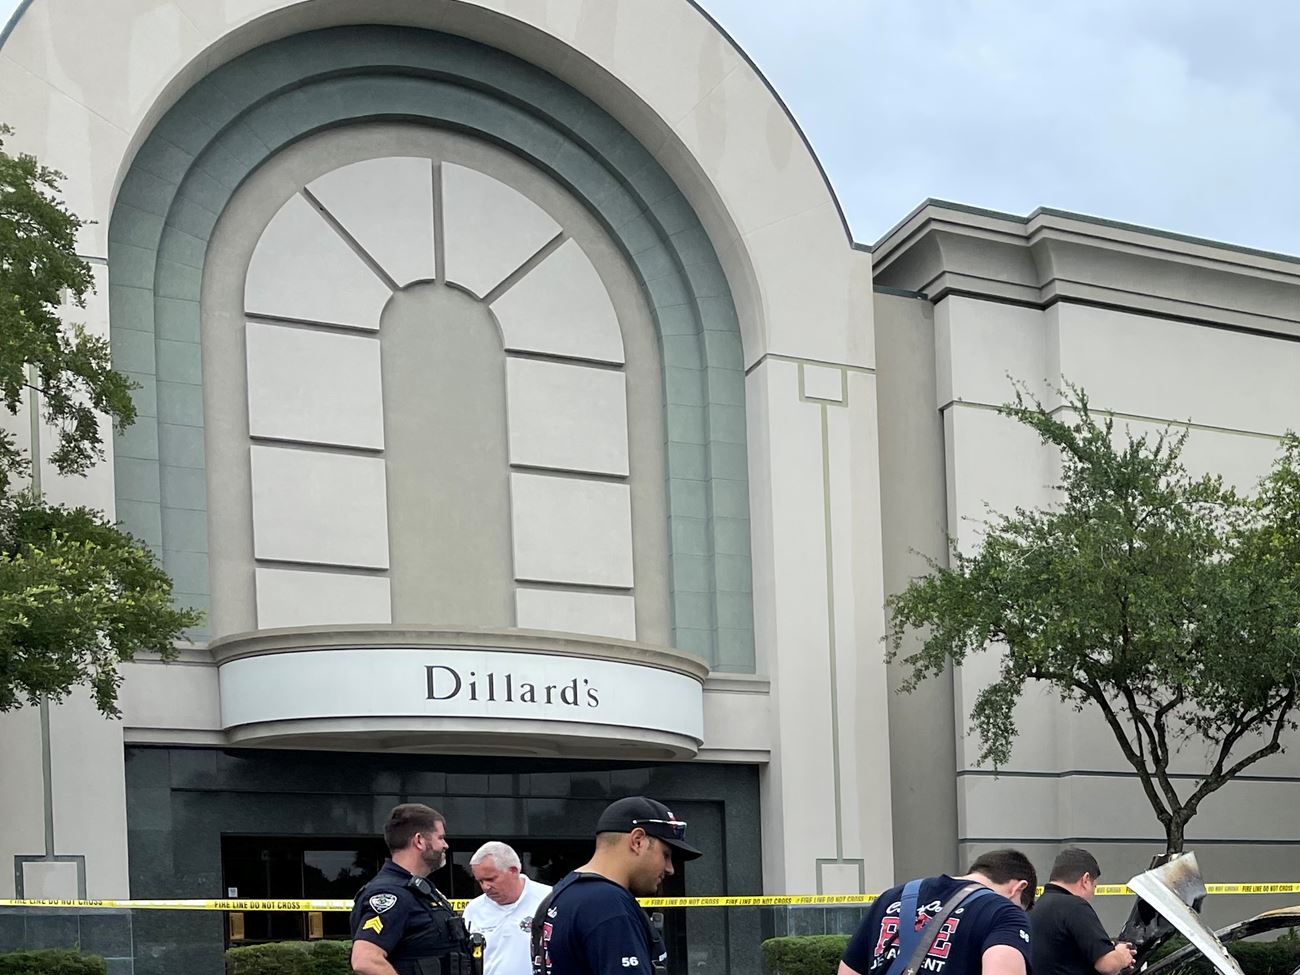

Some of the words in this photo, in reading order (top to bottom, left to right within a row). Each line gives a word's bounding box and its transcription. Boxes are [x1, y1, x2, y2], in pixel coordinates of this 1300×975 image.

[424, 665, 599, 708] Dillard's
[232, 901, 248, 909] LINE
[250, 901, 260, 909] DO
[262, 901, 275, 909] NOT
[277, 901, 300, 909] CROSS
[621, 956, 639, 967] 56
